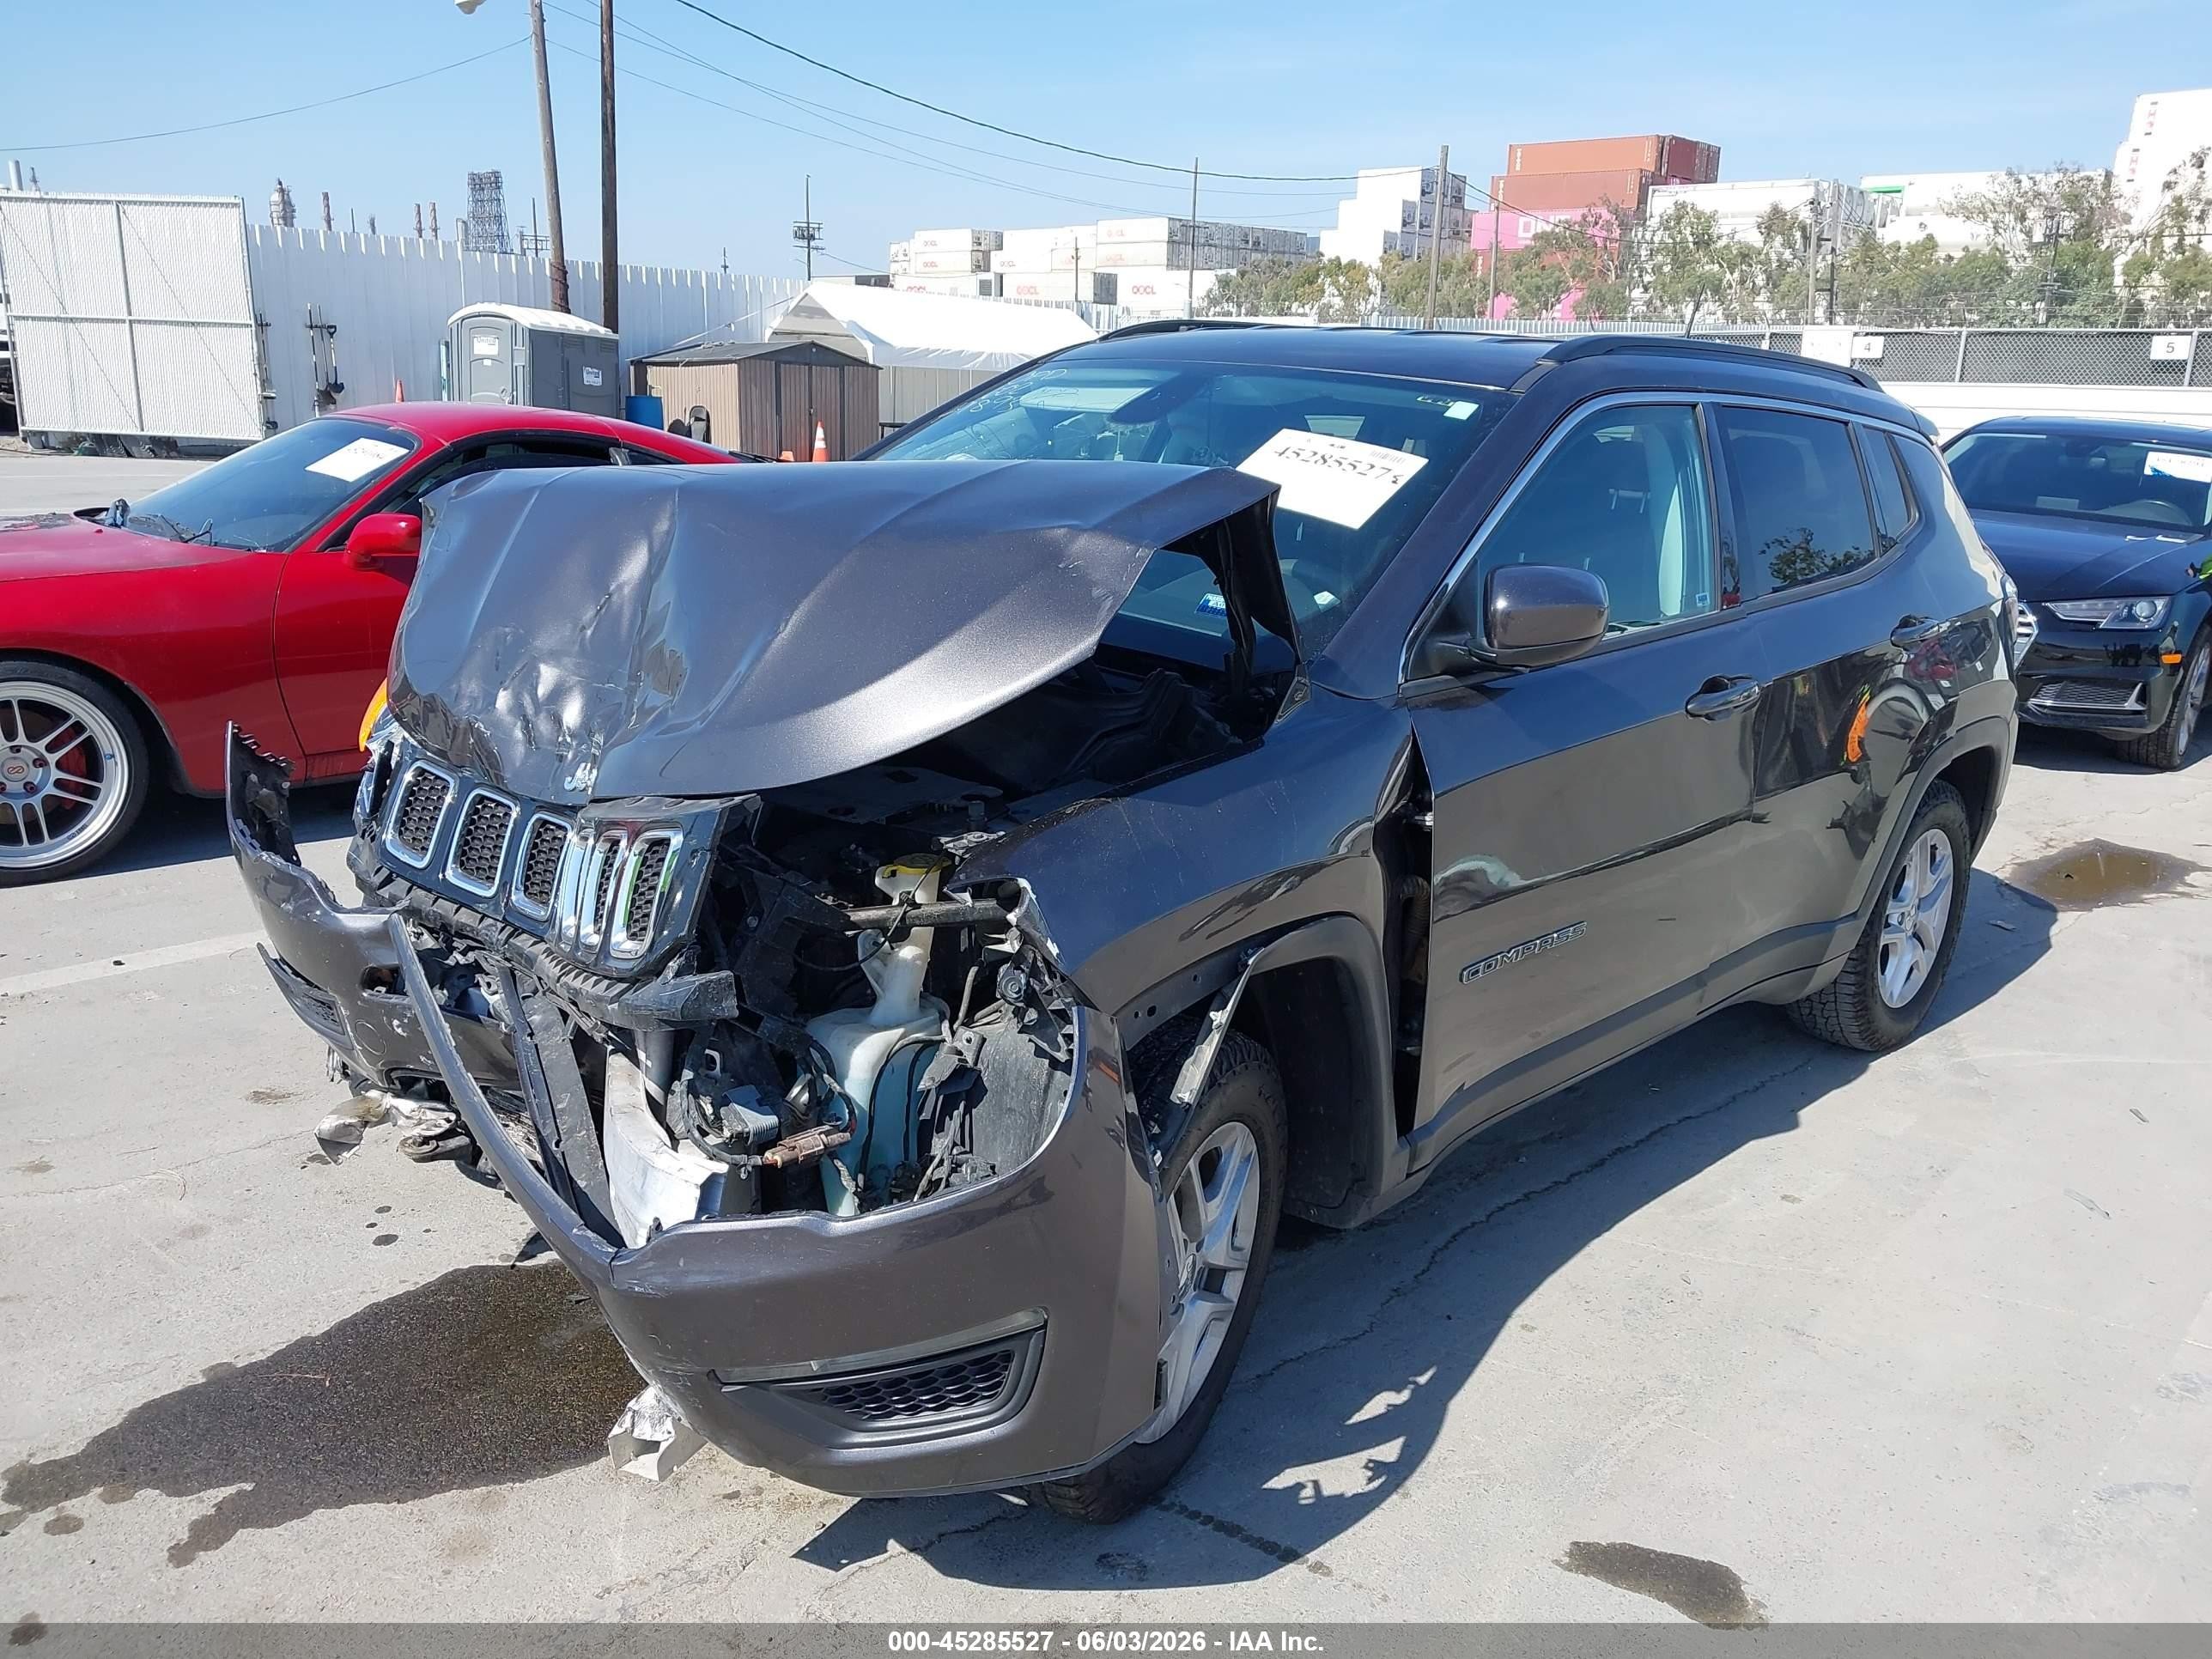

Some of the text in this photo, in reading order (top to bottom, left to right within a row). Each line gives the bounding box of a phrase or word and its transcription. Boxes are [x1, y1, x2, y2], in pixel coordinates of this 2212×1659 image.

[1016, 285, 1040, 295] OOCL
[1132, 285, 1157, 295] OOCL
[1863, 343, 1871, 352] 4
[2166, 343, 2175, 353] 5
[1460, 921, 1588, 984] COMPASS
